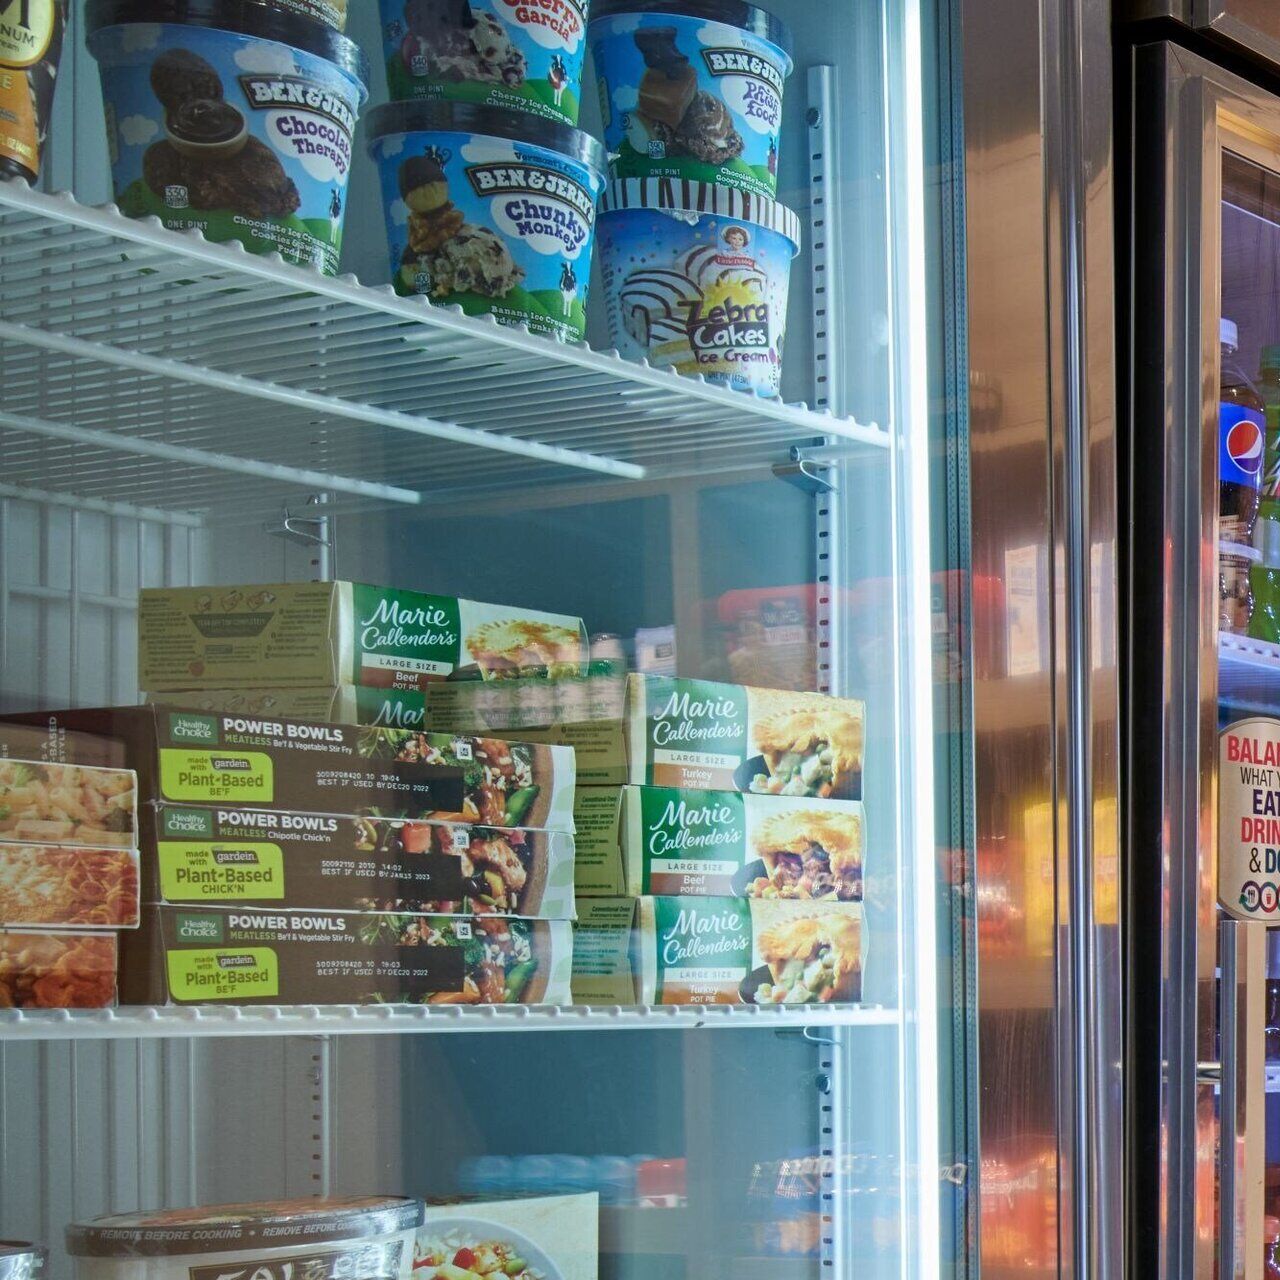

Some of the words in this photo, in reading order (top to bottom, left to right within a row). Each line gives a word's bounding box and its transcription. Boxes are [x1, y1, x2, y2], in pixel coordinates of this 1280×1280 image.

[515, 8, 570, 41] Garcia
[505, 199, 587, 244] Chunky
[517, 220, 577, 252] Monkey
[677, 296, 769, 325] Zebra
[694, 325, 767, 348] Cakes
[695, 349, 717, 364] Ice
[724, 349, 768, 364] Cream
[361, 599, 450, 627] Marie
[361, 627, 455, 649] Callender's
[380, 658, 412, 669] LARGE
[416, 662, 437, 671] SIZE
[654, 691, 737, 720] Marie
[223, 719, 283, 736] POWER
[287, 725, 343, 742] BOWLS
[654, 720, 742, 745] Callender's
[1240, 766, 1273, 787] WHAT
[218, 811, 279, 828] POWER
[282, 816, 338, 832] BOWLS
[650, 801, 735, 831] Marie
[650, 830, 740, 855] Callender's
[1249, 847, 1261, 873] &
[684, 876, 705, 885] Beef
[229, 915, 287, 930] POWER
[292, 918, 346, 930] BOWLS
[664, 910, 742, 940] Marie
[230, 931, 276, 941] MEATLESS
[186, 971, 268, 986] Plant-Based
[100, 1228, 142, 1239] REMOVE
[145, 1229, 190, 1240] BEFORE
[193, 1227, 242, 1239] COOKING
